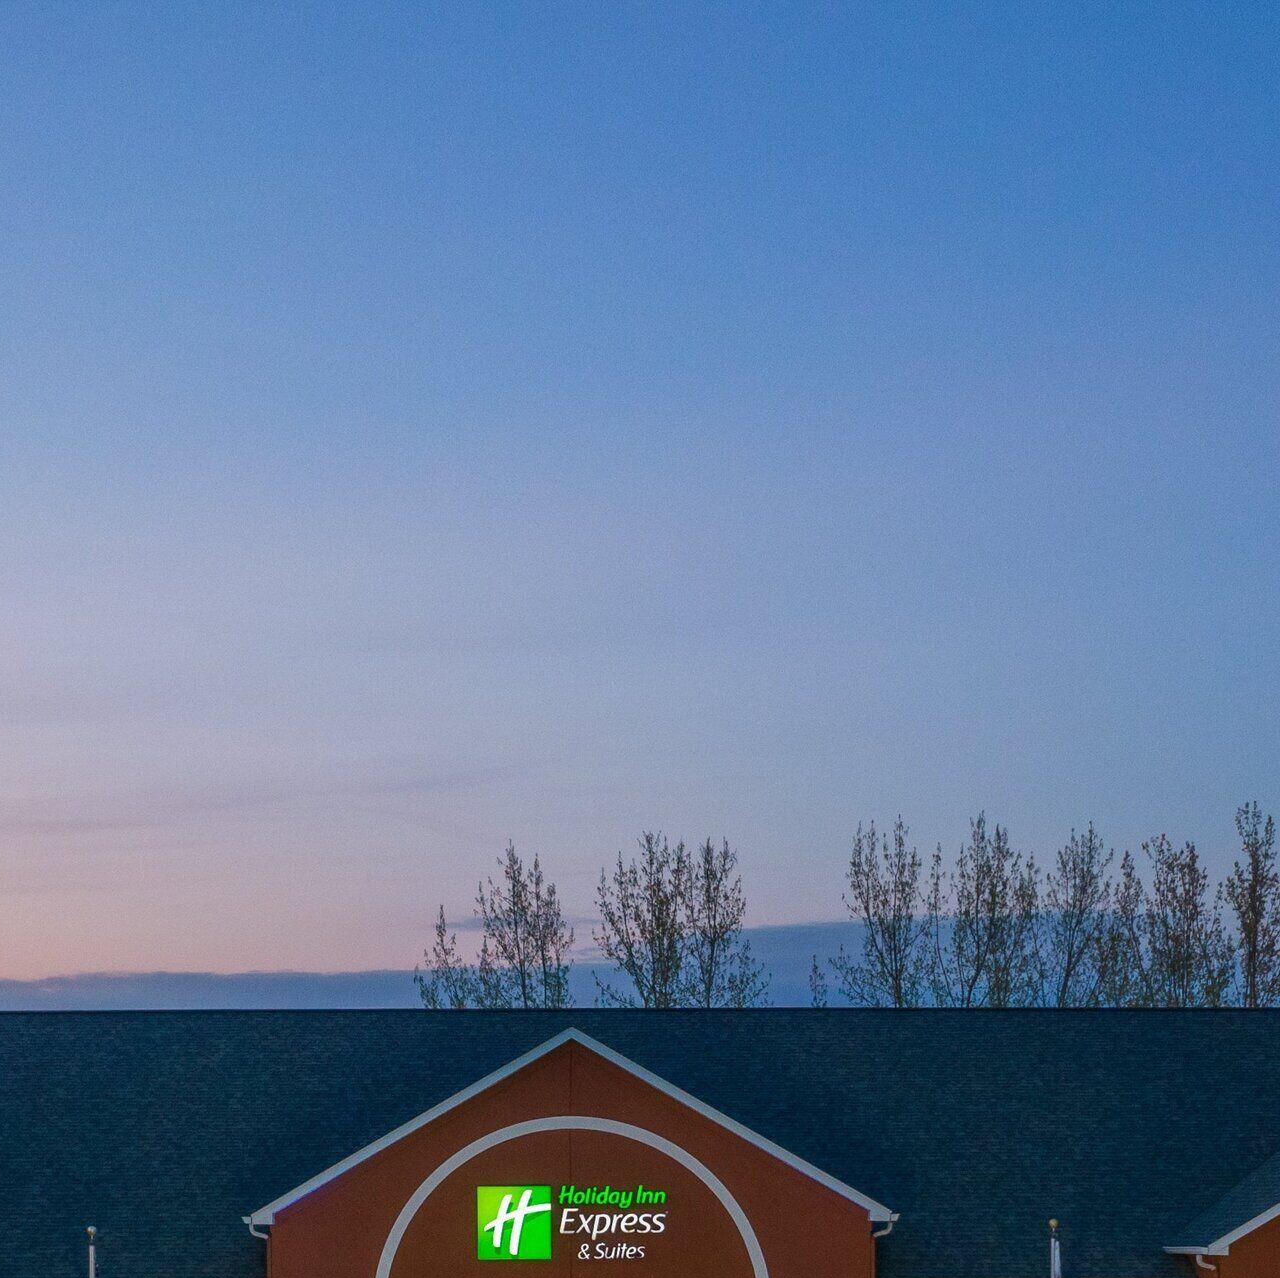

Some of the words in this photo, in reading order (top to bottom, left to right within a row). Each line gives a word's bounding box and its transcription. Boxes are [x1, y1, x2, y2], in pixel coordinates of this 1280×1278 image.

[558, 1185, 633, 1209] Holiday
[636, 1185, 667, 1204] Inn
[559, 1207, 667, 1241] Express
[577, 1243, 591, 1260] &
[593, 1242, 646, 1259] Suites
